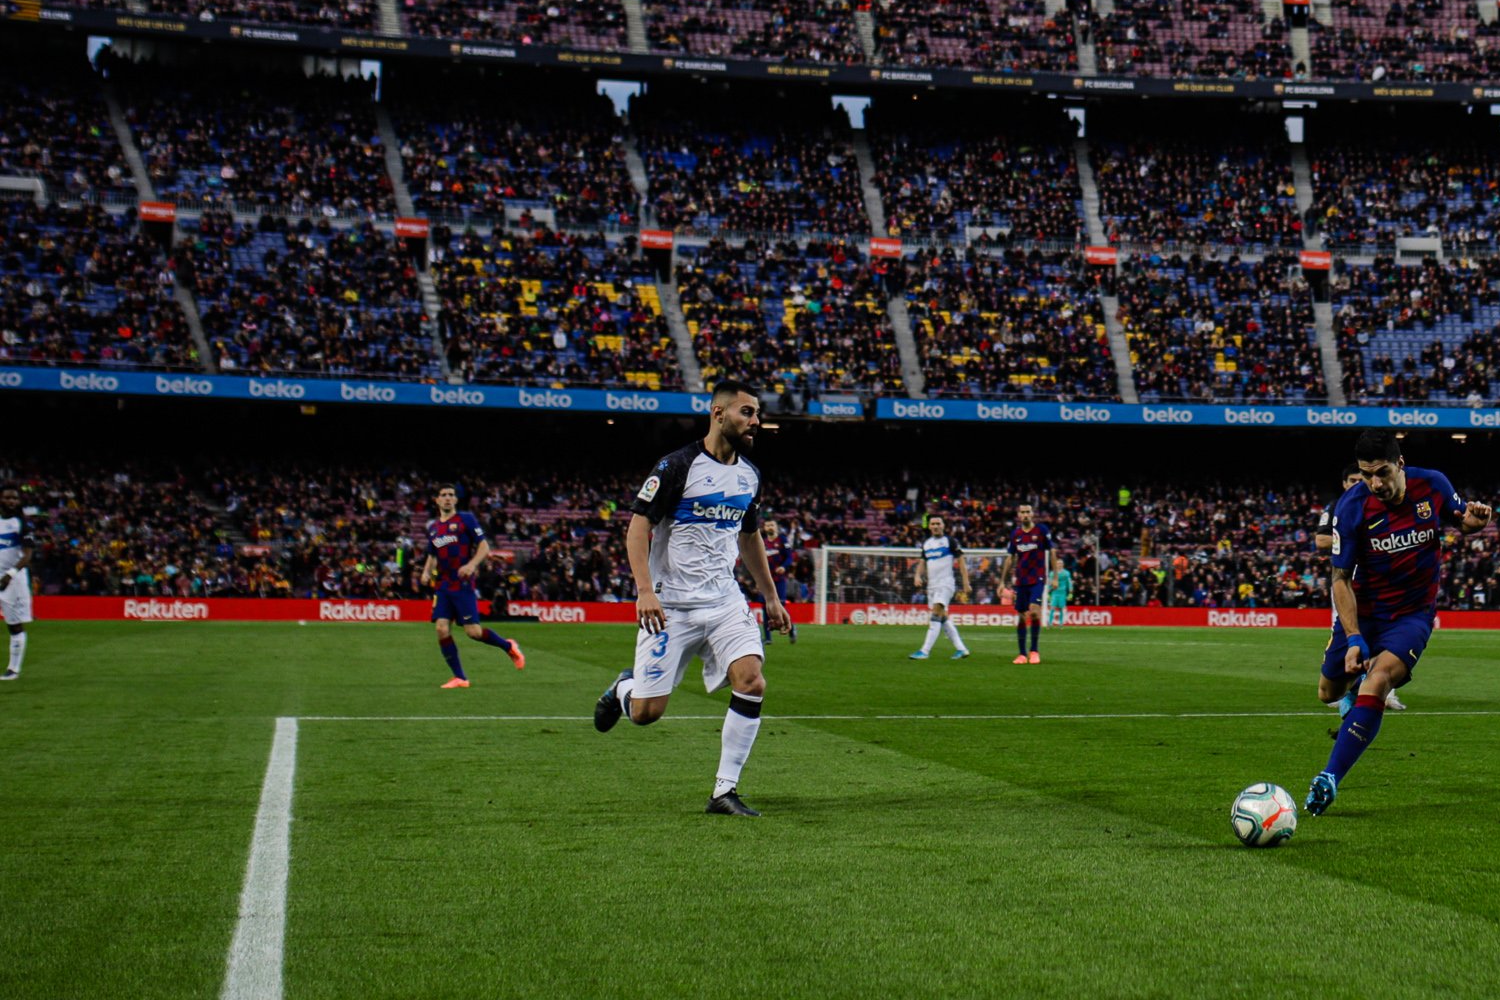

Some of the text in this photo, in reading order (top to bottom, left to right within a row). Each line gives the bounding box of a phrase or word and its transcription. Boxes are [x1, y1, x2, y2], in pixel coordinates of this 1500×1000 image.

[60, 371, 118, 390] beko
[155, 375, 212, 394] beko
[249, 380, 304, 398] beko
[341, 383, 395, 401] beko
[430, 387, 484, 404] beko
[519, 390, 572, 408] beko
[606, 393, 659, 411] beko
[691, 396, 712, 412] be
[822, 403, 856, 416] beko
[893, 401, 944, 419] beko
[977, 402, 1028, 420] beko
[1060, 405, 1110, 421] beko
[1143, 406, 1192, 423] beko
[1225, 408, 1275, 424] beko
[1307, 409, 1357, 425] beko
[1388, 410, 1438, 426] beko
[1370, 528, 1434, 552] Rakuten
[124, 600, 208, 619] Rakuten
[320, 601, 400, 620] Rakuten
[1208, 610, 1277, 627] Rakuten
[651, 631, 669, 657] 3
